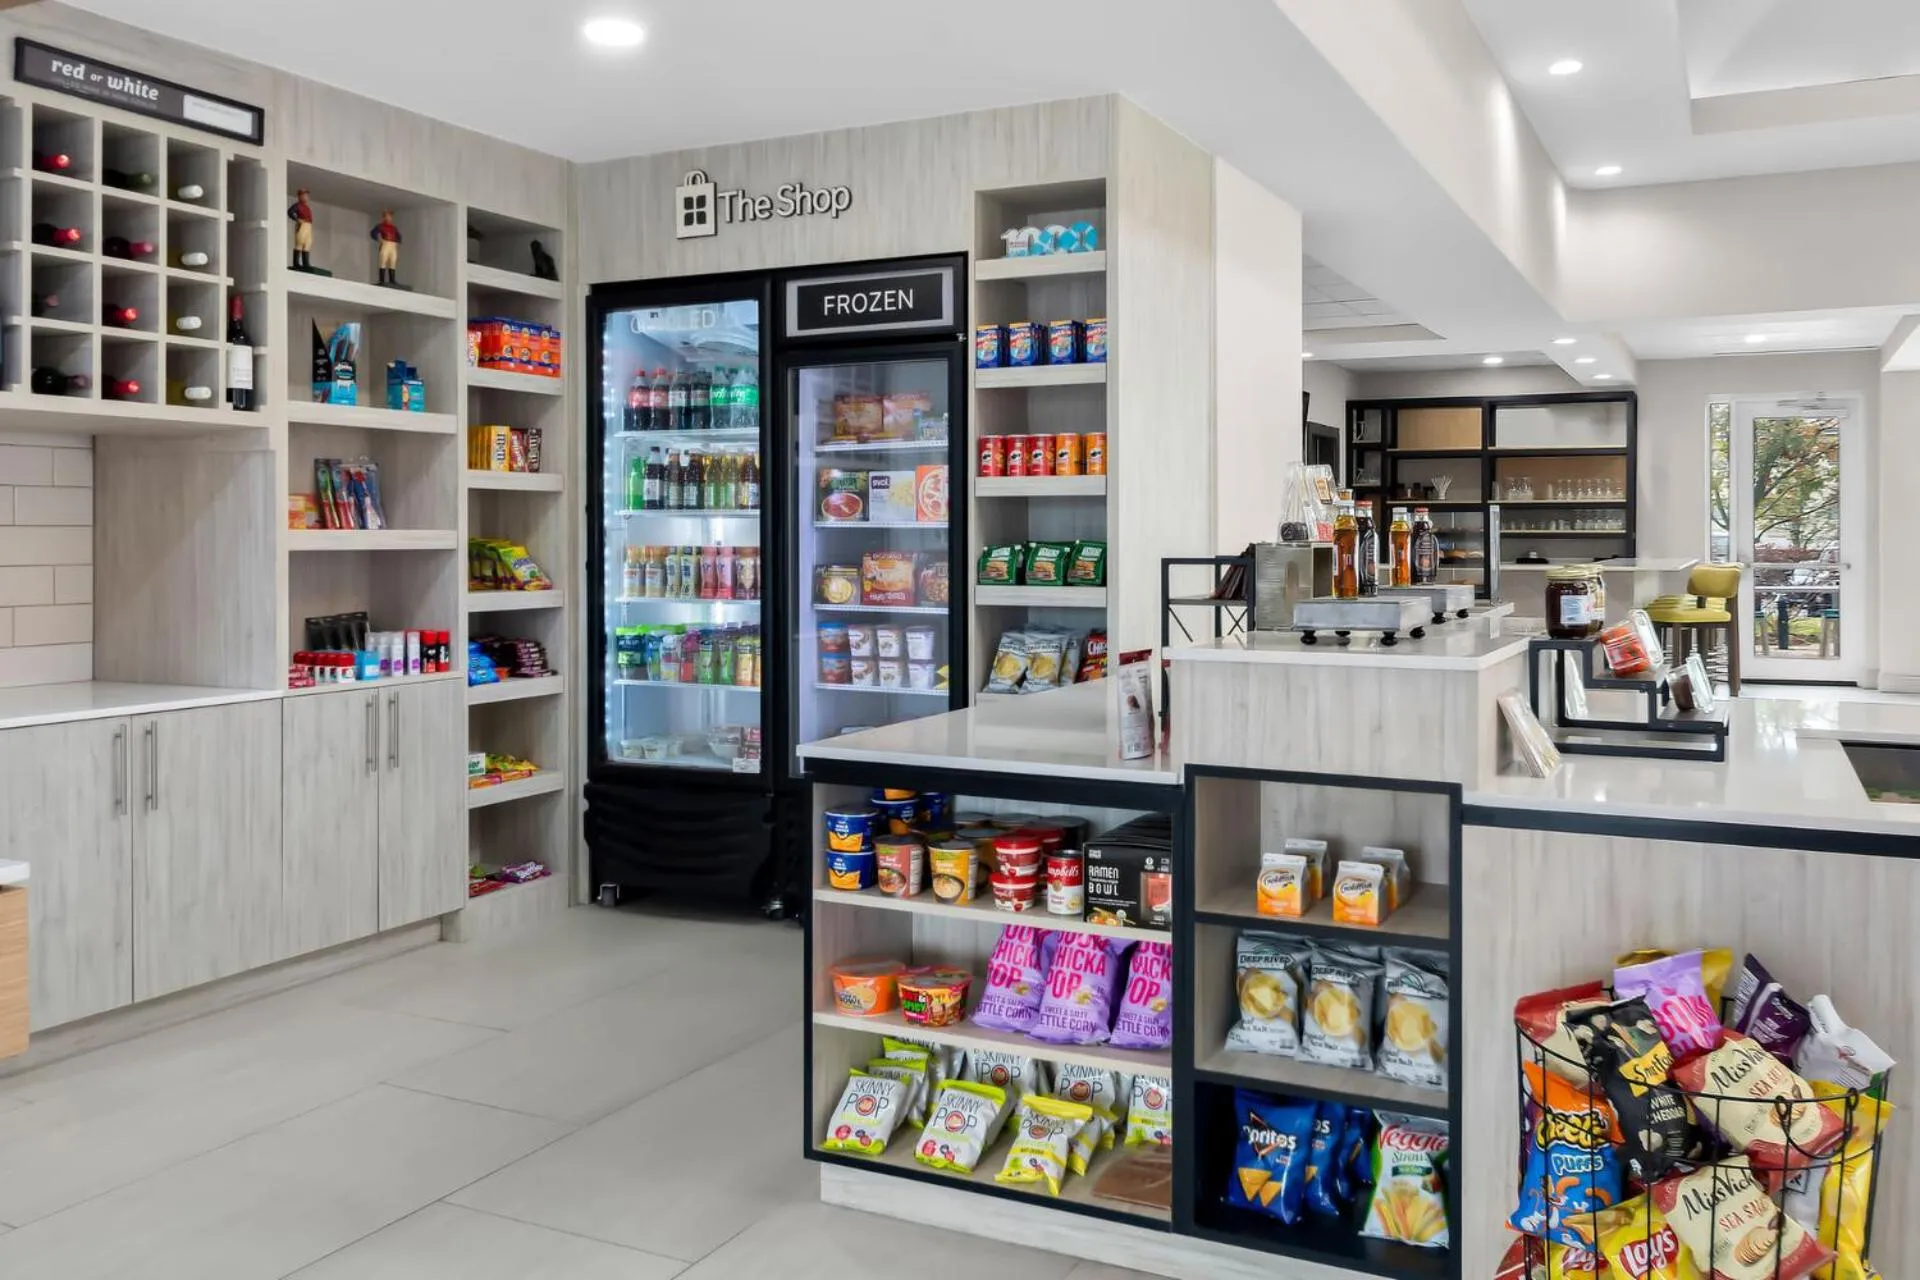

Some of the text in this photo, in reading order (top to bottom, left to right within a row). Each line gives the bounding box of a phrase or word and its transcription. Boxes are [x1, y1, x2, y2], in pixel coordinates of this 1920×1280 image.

[51, 58, 85, 80] red
[90, 72, 104, 82] or
[107, 75, 160, 102] white
[717, 182, 853, 223] The Shop
[823, 289, 915, 317] FROZEN
[1047, 864, 1079, 877] mpbell's
[1088, 865, 1120, 879] RAMEN
[1088, 882, 1119, 896] BOWL
[1055, 946, 1106, 976] HICKA
[1129, 976, 1160, 1007] OP
[1040, 1013, 1067, 1027] ETTLE
[1117, 1019, 1141, 1035] ETTLE
[1063, 1062, 1105, 1078] SKINNY
[1710, 1060, 1752, 1095] Miss
[852, 1078, 896, 1096] SKINNY
[1060, 1077, 1103, 1101] POP
[1749, 1079, 1772, 1098] SEA
[843, 1092, 889, 1119] POP
[945, 1094, 984, 1113] SKINNY
[1651, 1094, 1676, 1109] WHITE
[932, 1106, 978, 1135] POP
[1536, 1112, 1606, 1149] Cheet
[1682, 1188, 1728, 1221] Miss
[1719, 1211, 1745, 1233] SEA
[1623, 1229, 1675, 1274] Lay's
